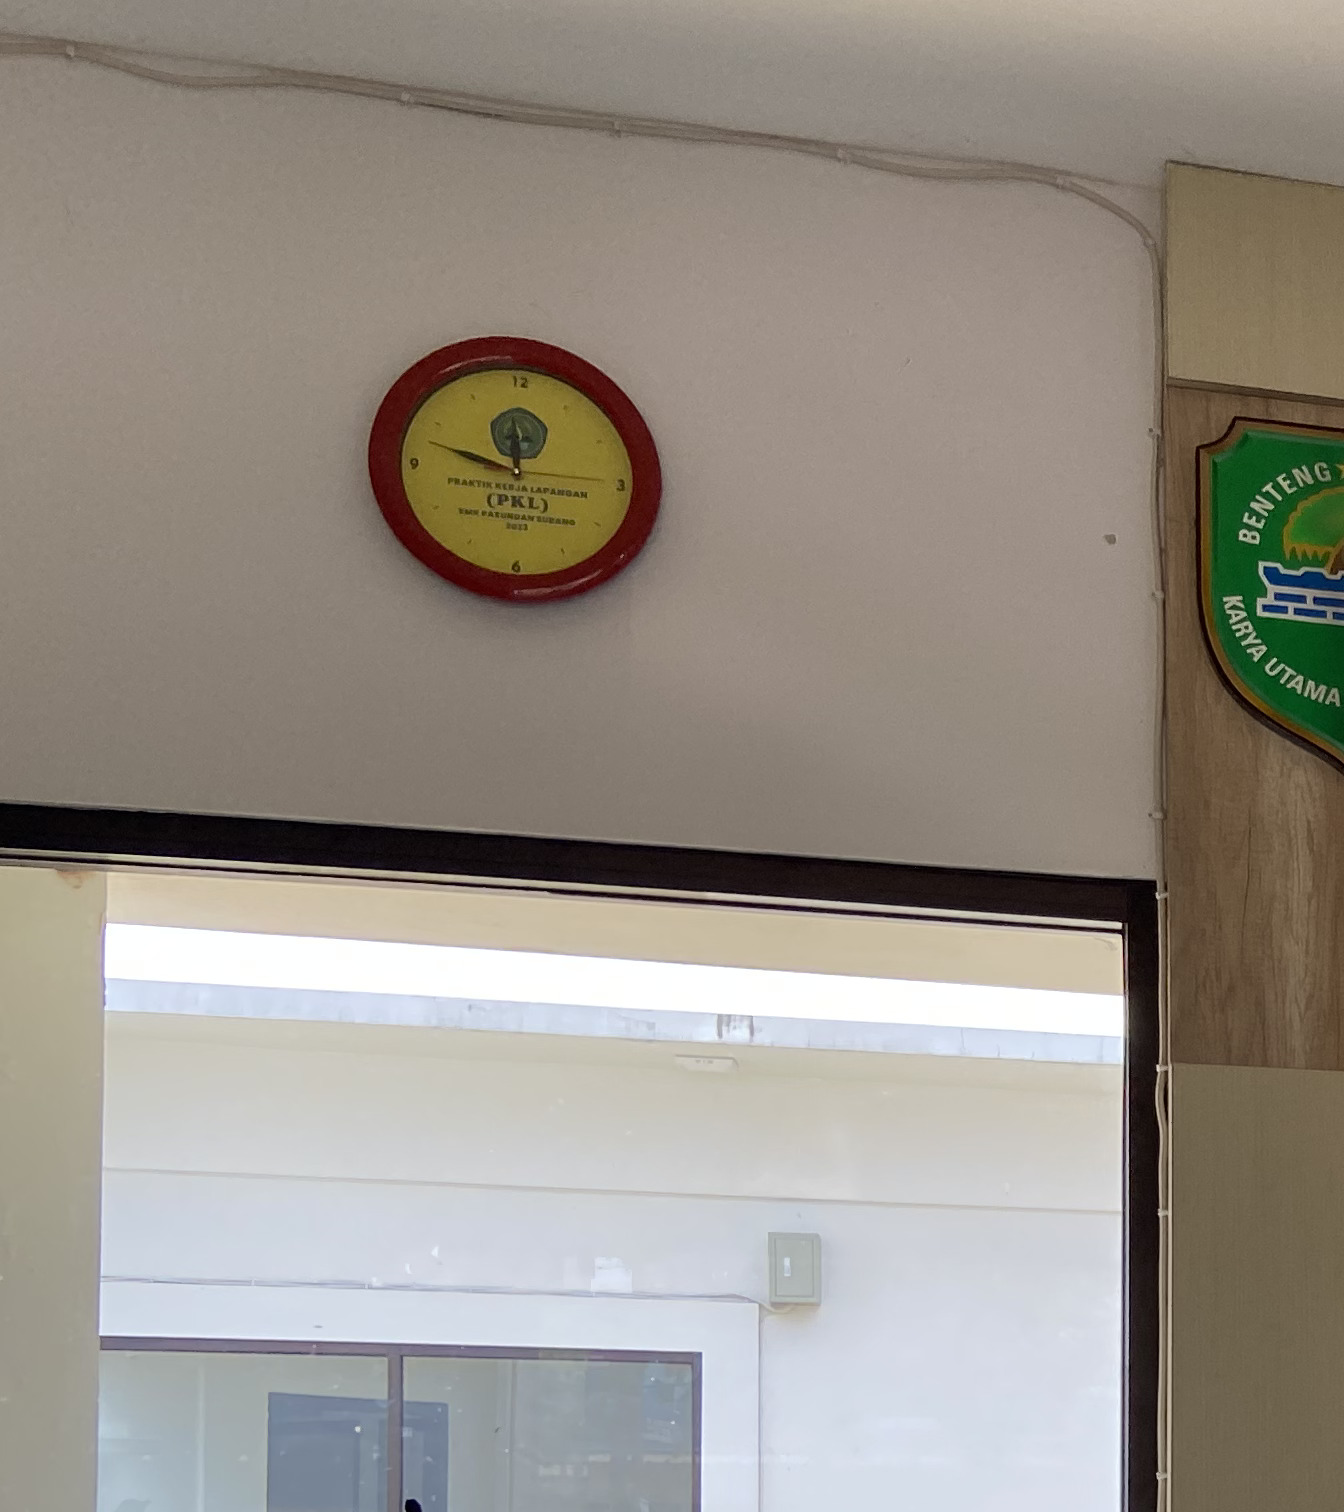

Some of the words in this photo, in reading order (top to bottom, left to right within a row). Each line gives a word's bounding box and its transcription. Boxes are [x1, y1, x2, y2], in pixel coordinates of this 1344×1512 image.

[512, 376, 529, 389] 12
[409, 458, 419, 470] 9
[447, 477, 493, 489] PRAKTIK
[495, 482, 528, 493] KERJA
[530, 486, 588, 499] LAPANGAN
[616, 480, 626, 492] 3
[487, 493, 548, 513] (PKL)
[1238, 461, 1332, 545] BENTENG
[511, 560, 521, 572] 6
[1222, 595, 1269, 663] KARYA
[1264, 657, 1341, 707] UTAMA
